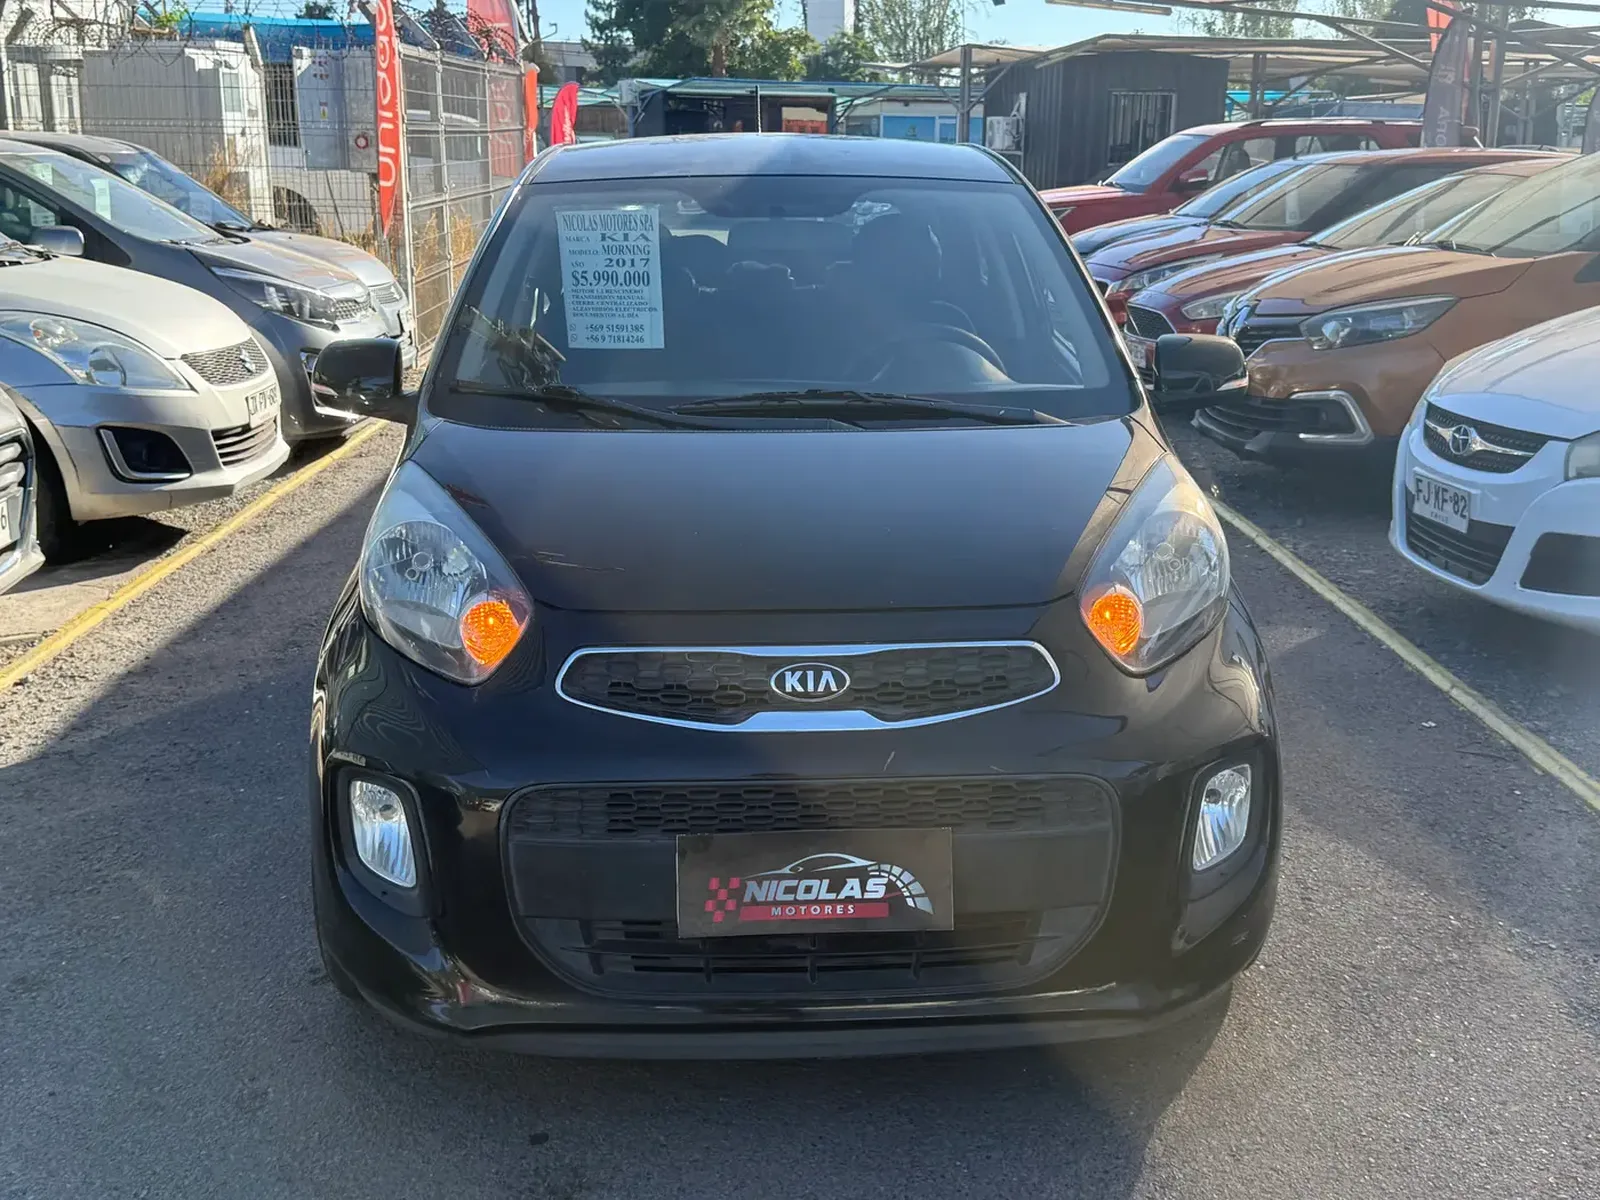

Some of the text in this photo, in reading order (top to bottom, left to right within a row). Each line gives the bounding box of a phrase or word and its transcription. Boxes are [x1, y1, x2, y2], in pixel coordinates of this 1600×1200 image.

[562, 213, 654, 232] NICOLAS MOTORES SPA
[600, 232, 653, 242] KIA
[601, 244, 651, 256] MORNING
[604, 258, 650, 268] 2017
[571, 270, 651, 288] $5.990.000
[784, 670, 839, 692] KIA
[743, 877, 889, 903] NICOLAS
[770, 904, 856, 917] MOTORES
